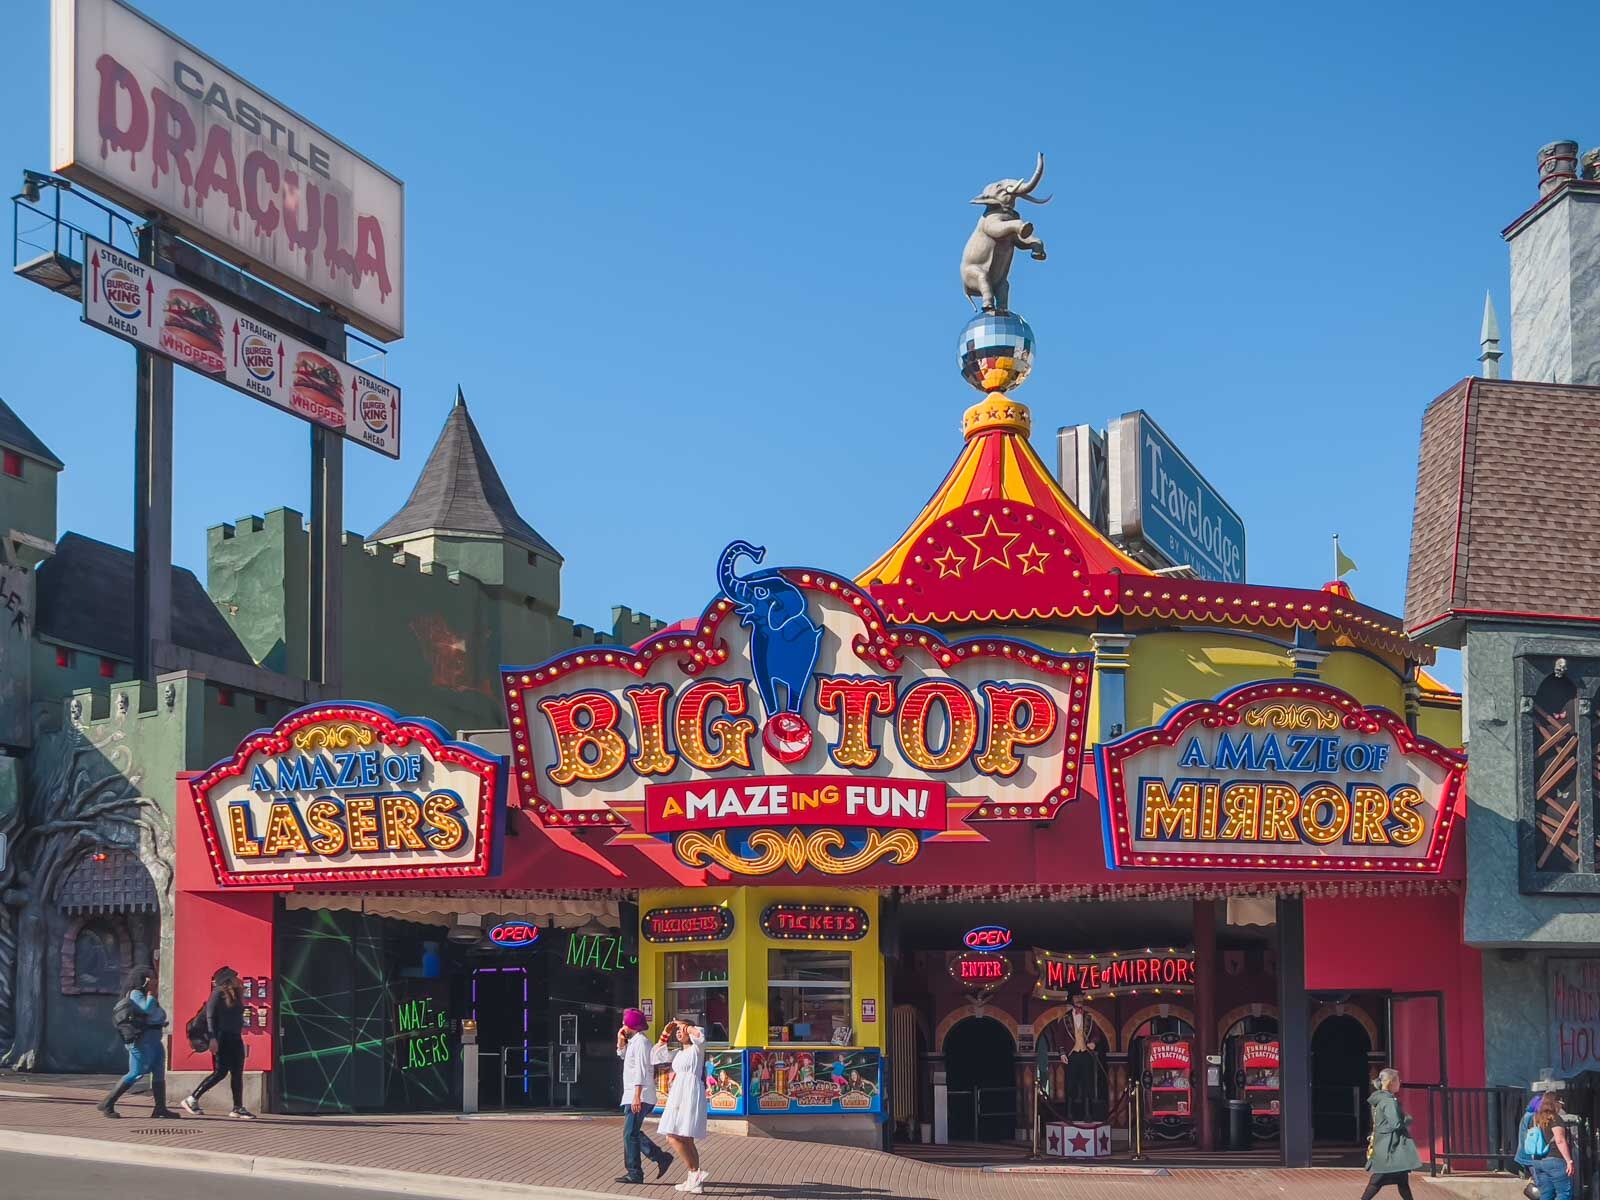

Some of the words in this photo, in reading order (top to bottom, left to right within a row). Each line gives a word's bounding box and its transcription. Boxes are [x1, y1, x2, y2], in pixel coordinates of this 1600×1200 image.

[173, 60, 330, 180] CASTLE
[95, 53, 393, 304] DRACULA
[100, 249, 145, 278] STRAIGHT
[106, 279, 139, 293] BURGER
[107, 289, 141, 305] KING
[108, 315, 138, 337] AHEAD
[240, 318, 277, 344] STRAIGHT
[163, 334, 226, 371] WHOPPER
[245, 346, 272, 356] BURGER
[246, 354, 274, 368] KING
[246, 378, 272, 397] AHEAD
[358, 376, 390, 398] STRAIGHT
[292, 394, 344, 425] WHOPPER
[362, 401, 386, 411] BURGER
[363, 409, 387, 421] KING
[363, 430, 385, 447] AHEAD
[1146, 432, 1240, 584] Travelodge
[1169, 535, 1180, 553] BY
[1183, 548, 1217, 581] WYNDH
[537, 678, 757, 785] BIG
[815, 675, 1059, 779] TOP
[1178, 737, 1209, 769] A
[1213, 732, 1341, 773] MAZE
[1341, 743, 1390, 773] OF
[250, 764, 271, 792] A
[275, 750, 381, 792] MAZE
[382, 752, 421, 783] OF
[846, 785, 929, 818] FUN!
[227, 792, 466, 857] LASERS
[491, 926, 539, 942] OPEN
[652, 916, 718, 933] TICKETS
[777, 914, 856, 931] TICKETS
[965, 930, 1011, 946] OPEN
[566, 933, 625, 971] MAZE
[960, 961, 1002, 978] ENTER
[1046, 960, 1100, 989] MAZE
[1101, 966, 1112, 982] of
[398, 998, 434, 1031] MAZE
[402, 1033, 449, 1070] ASERS
[1150, 1051, 1189, 1062] ATTRACTIONS
